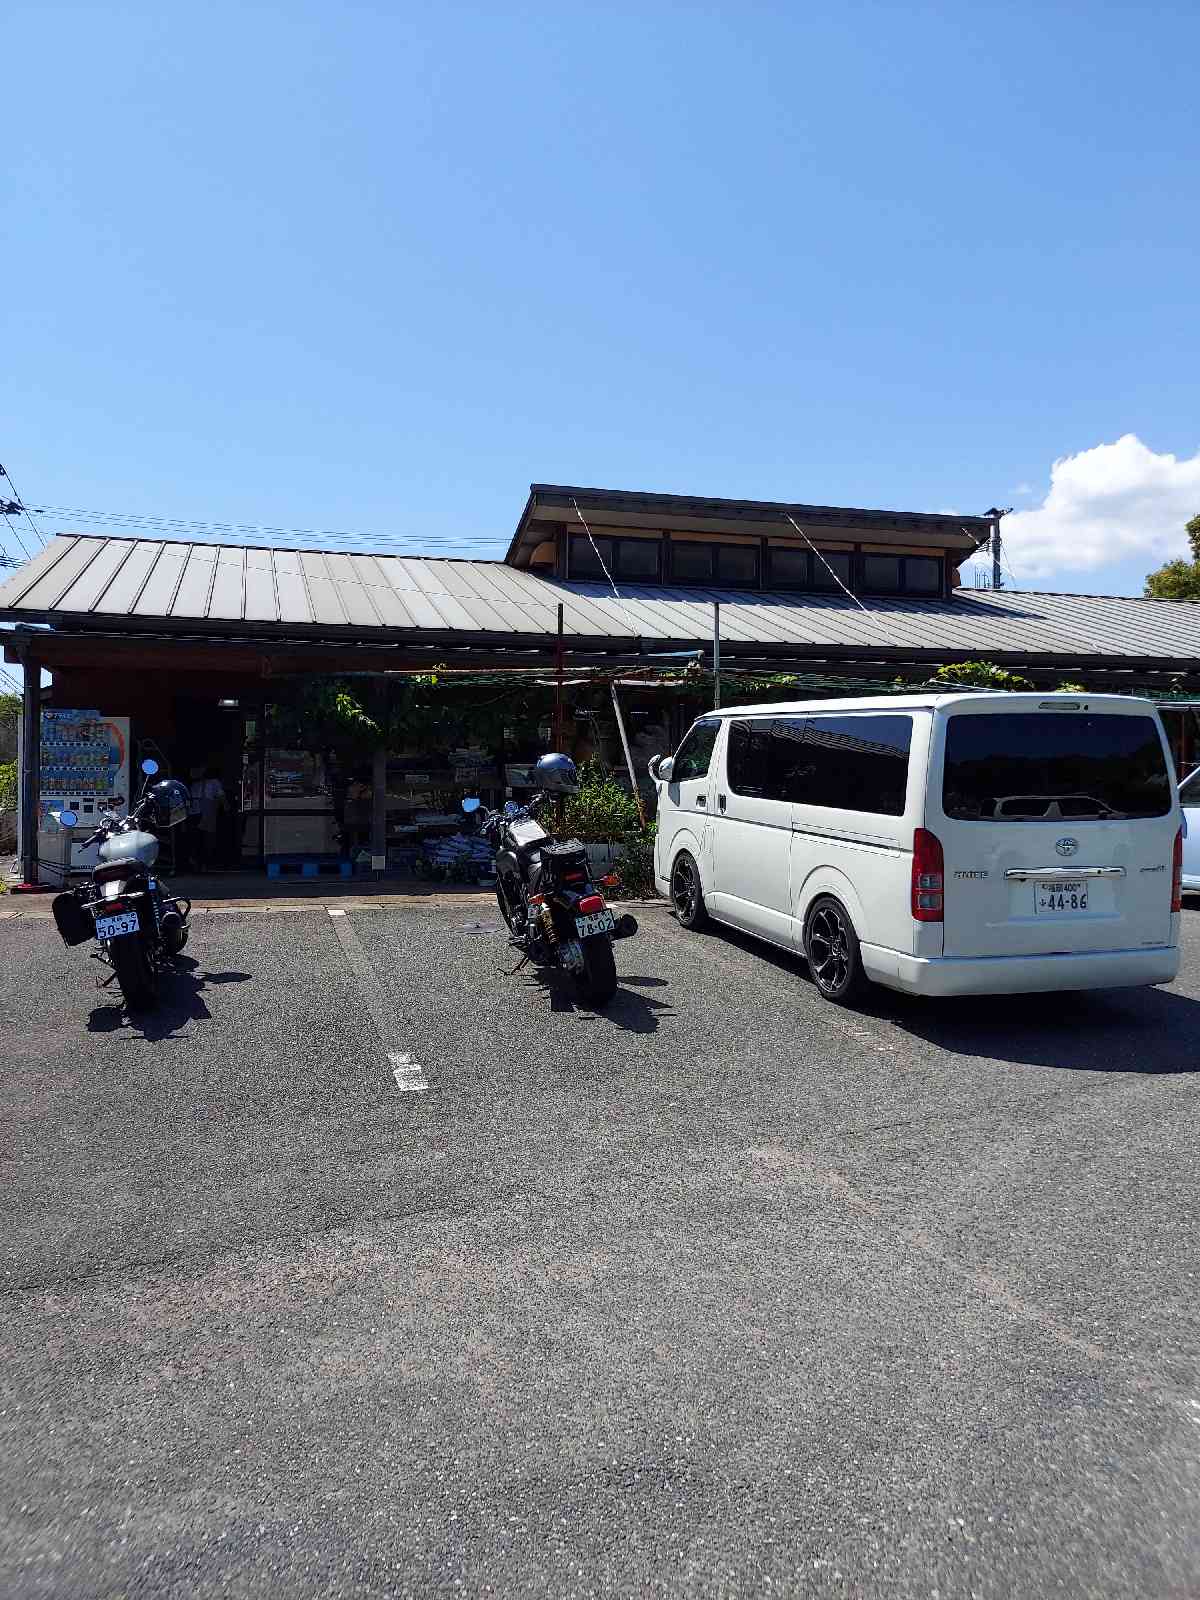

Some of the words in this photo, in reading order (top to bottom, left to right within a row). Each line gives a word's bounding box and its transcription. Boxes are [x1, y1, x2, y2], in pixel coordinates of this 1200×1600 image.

[1048, 894, 1087, 910] 44-86
[98, 919, 137, 939] 50-97
[578, 918, 613, 936] 78-02
